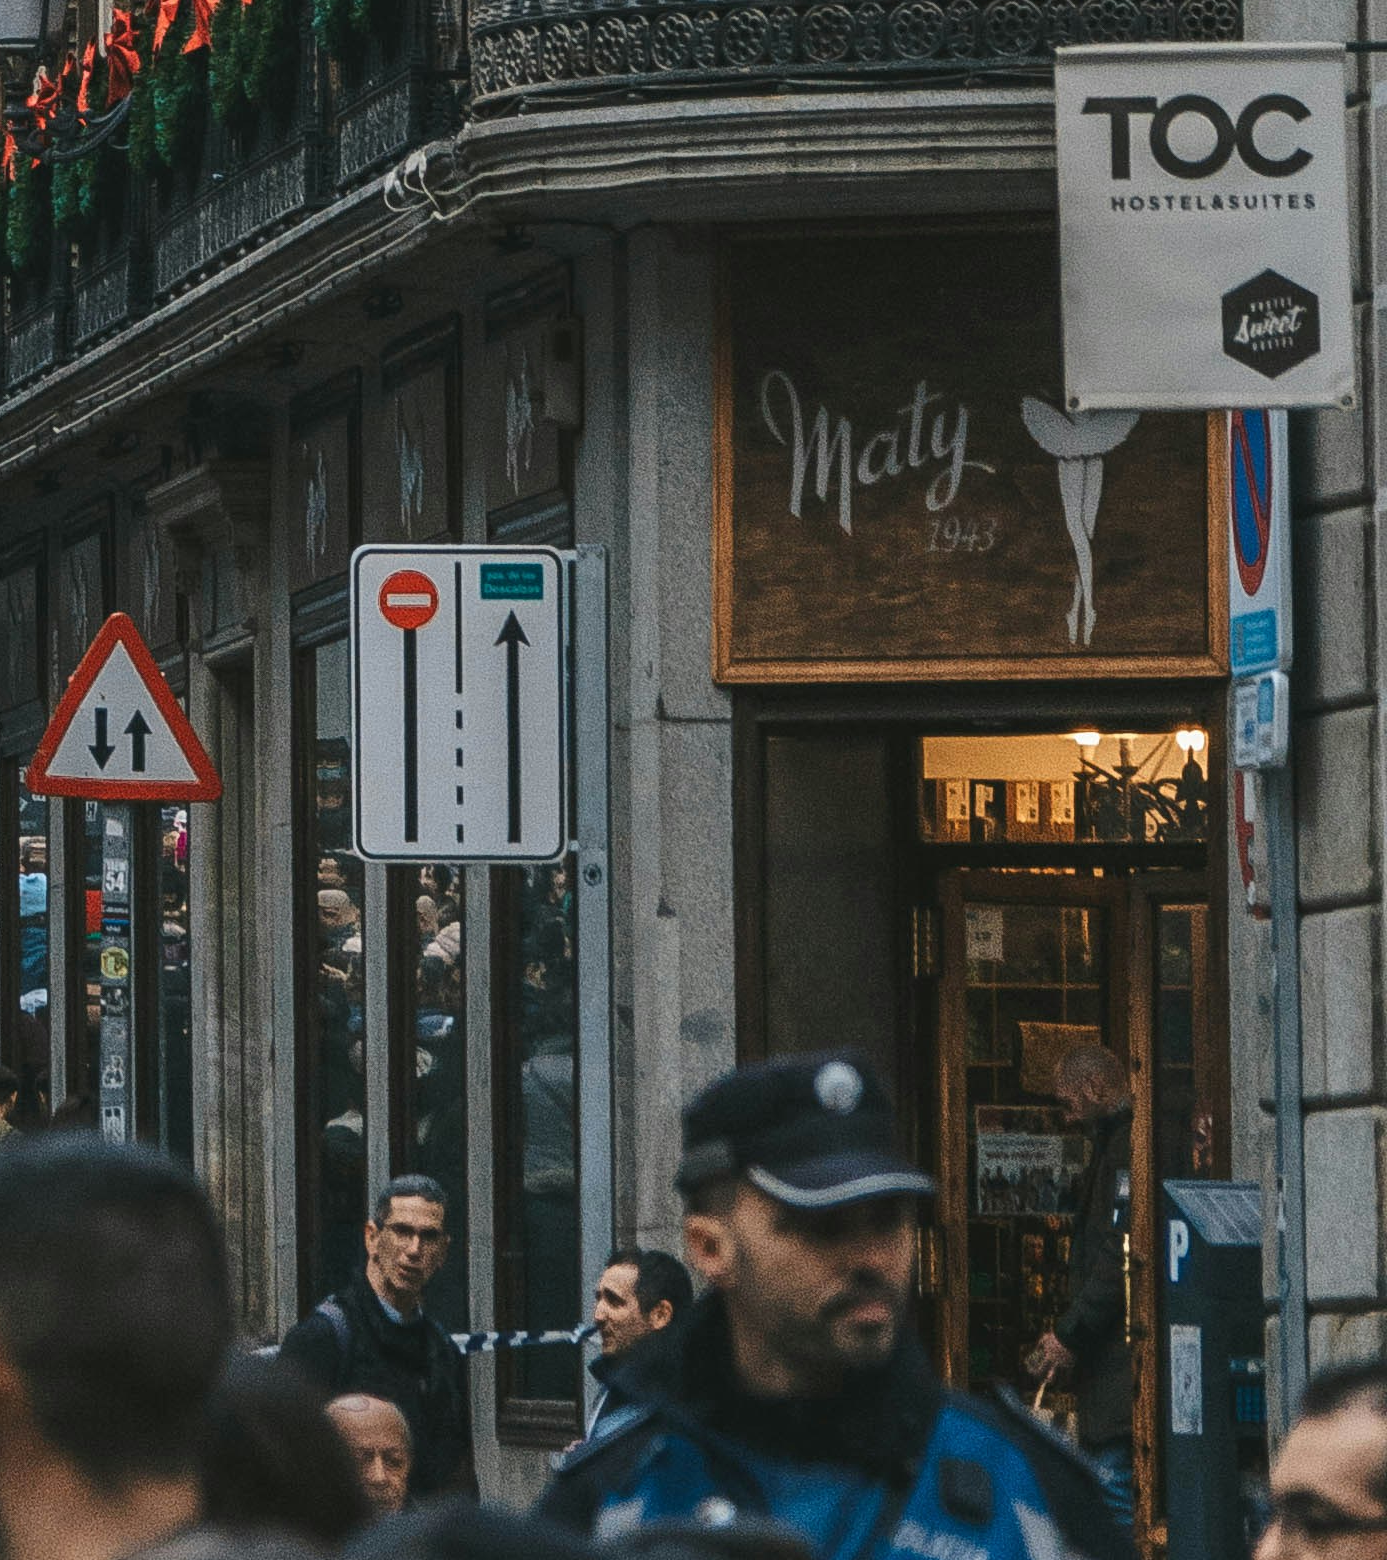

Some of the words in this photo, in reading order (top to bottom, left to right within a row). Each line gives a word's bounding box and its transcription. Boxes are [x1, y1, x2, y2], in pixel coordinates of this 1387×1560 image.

[1081, 93, 1314, 181] TOC
[1111, 194, 1316, 213] HOSTEL&SUITES
[762, 370, 996, 536] Maty
[928, 517, 997, 552] 1943
[1169, 1219, 1189, 1282] P
